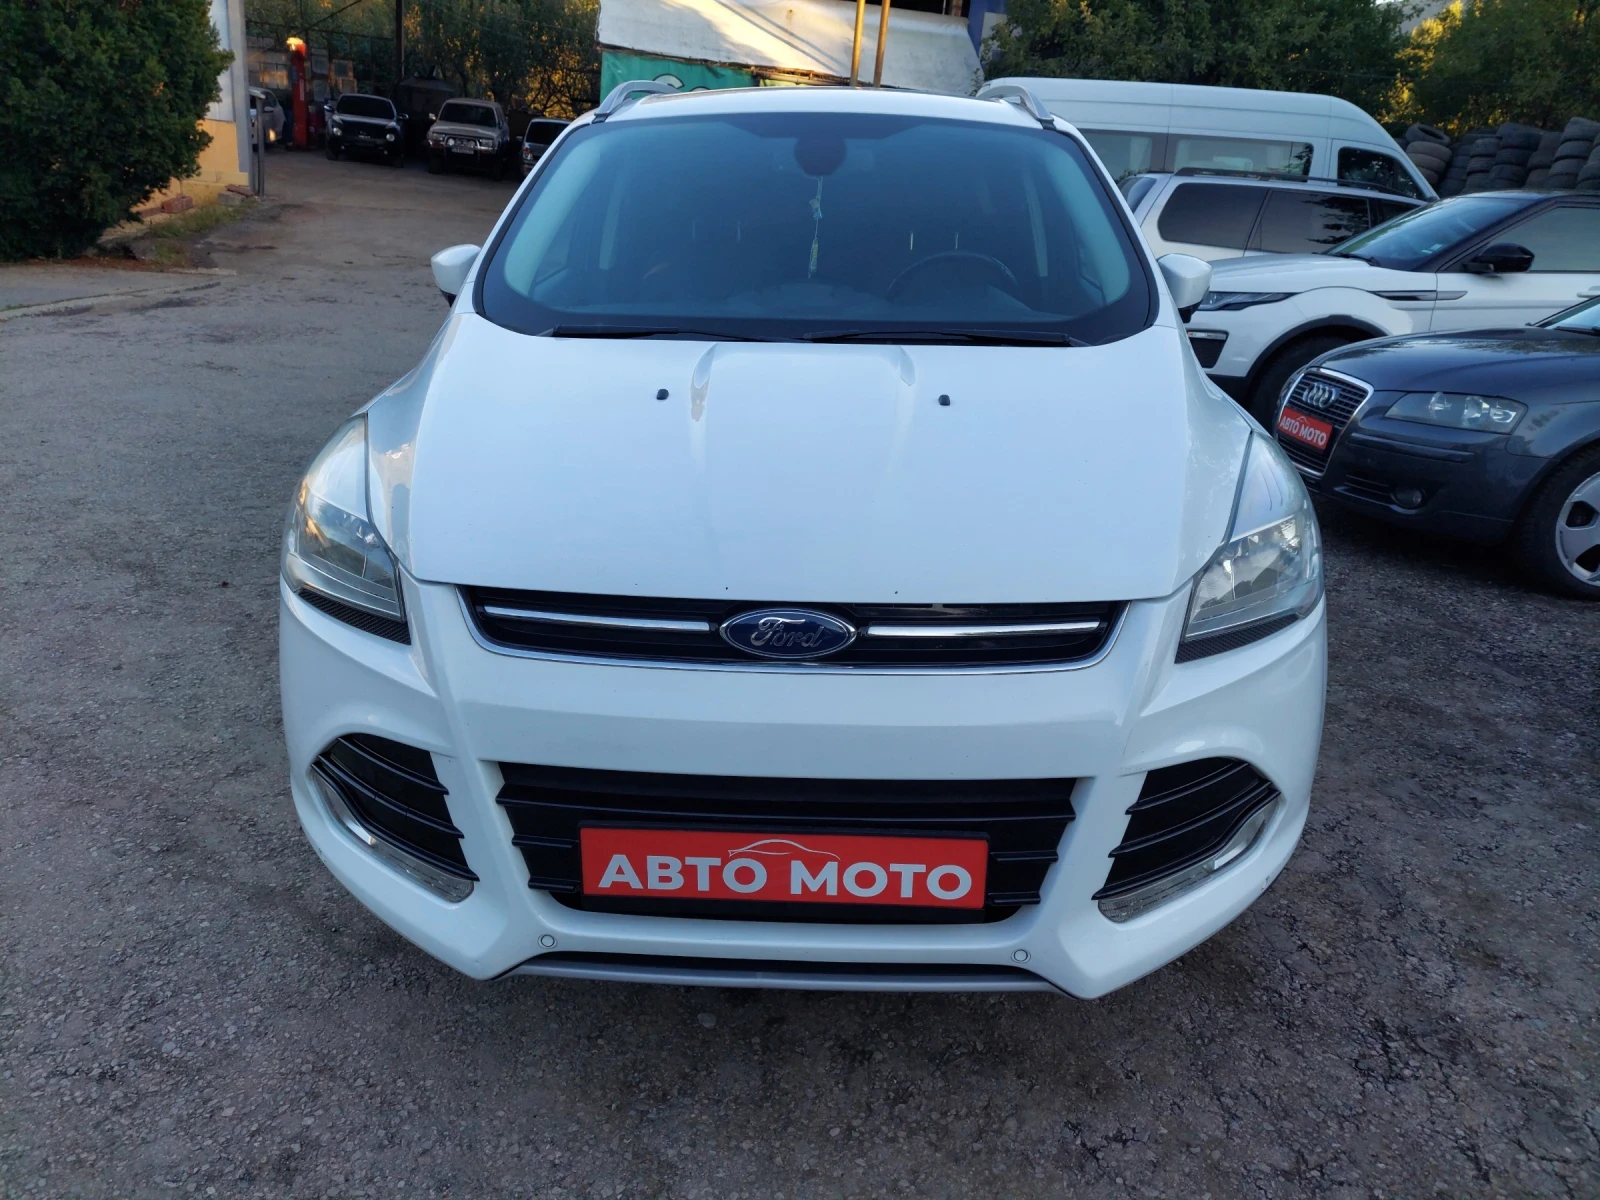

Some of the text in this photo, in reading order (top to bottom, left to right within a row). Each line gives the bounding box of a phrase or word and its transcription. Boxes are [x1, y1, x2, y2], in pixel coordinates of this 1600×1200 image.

[1280, 417, 1327, 445] АВТО МОТО
[750, 616, 825, 647] Ford
[598, 854, 972, 900] АВТО МОТО
